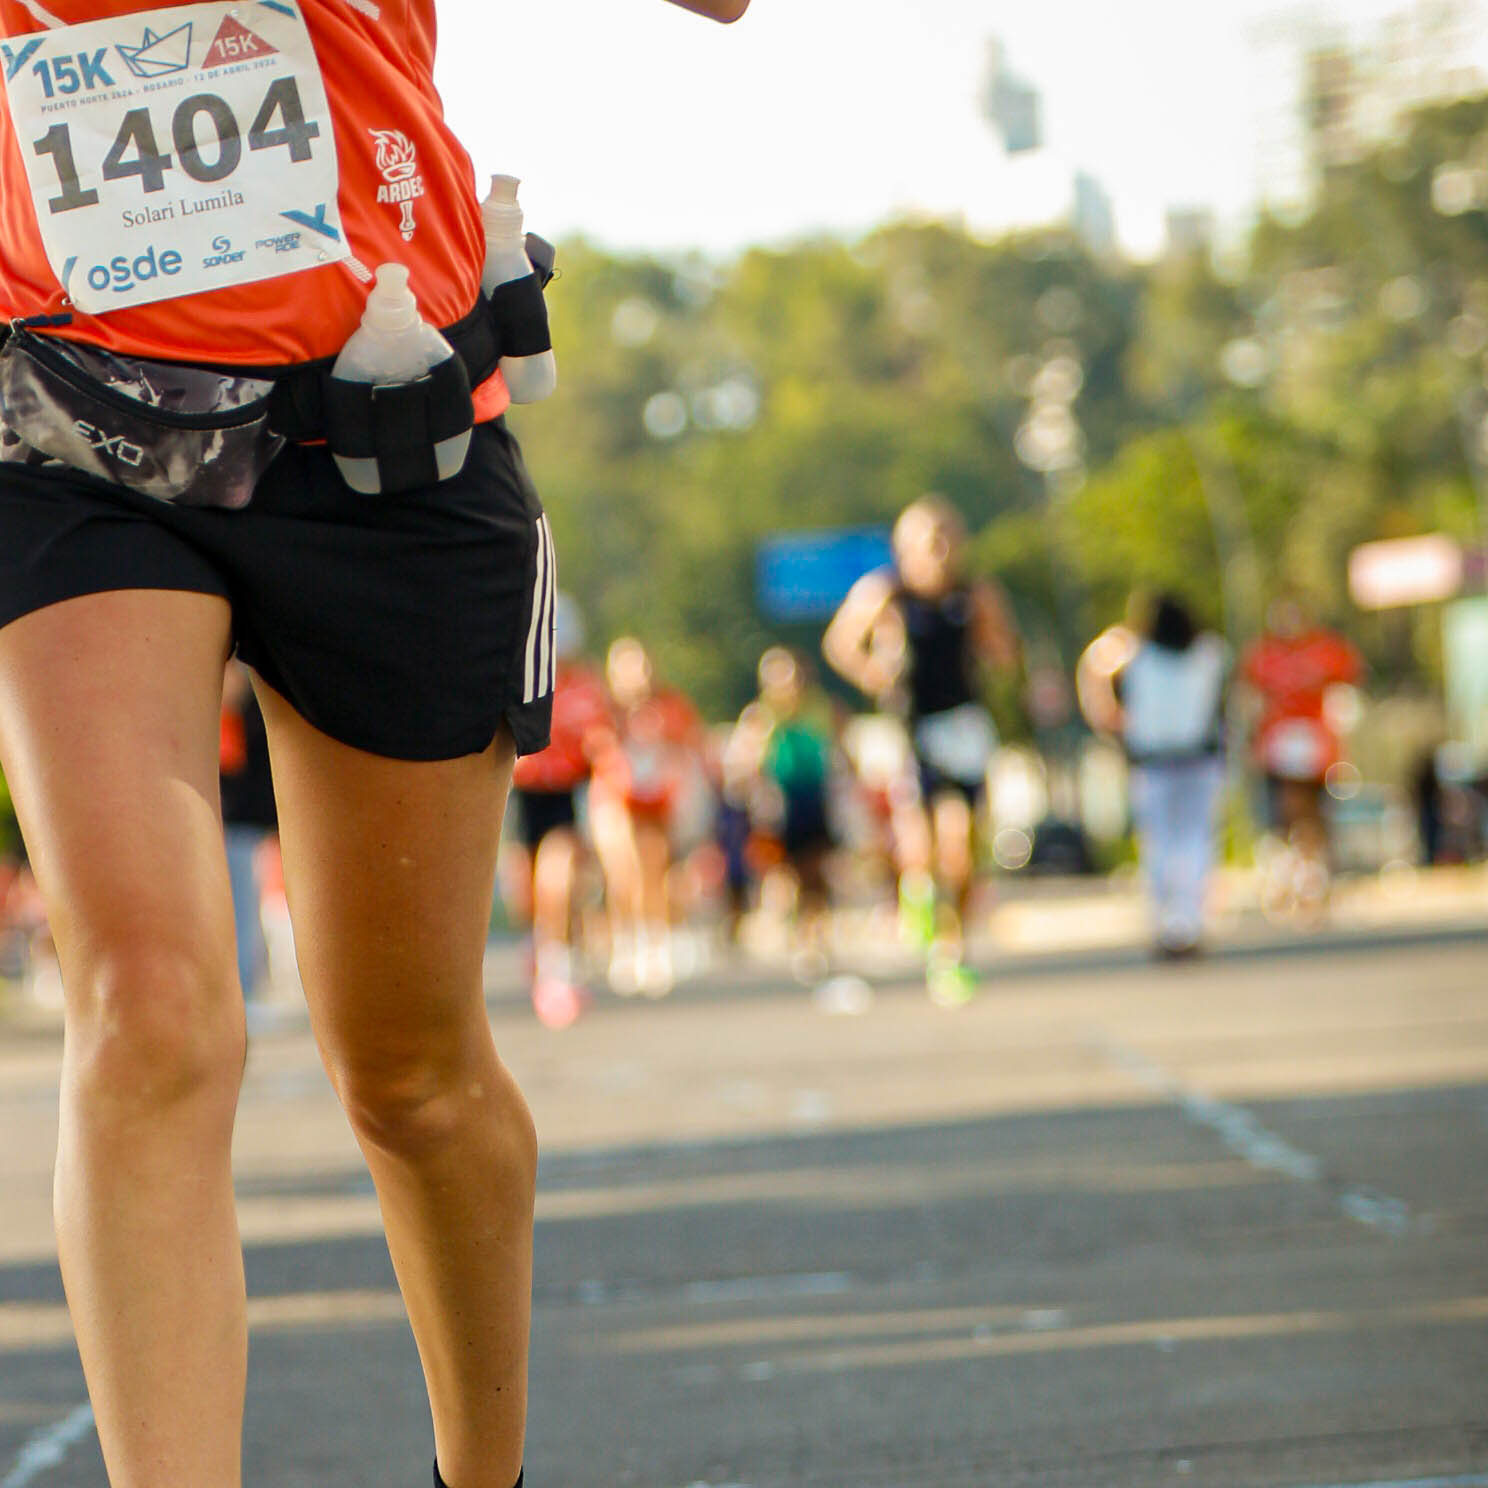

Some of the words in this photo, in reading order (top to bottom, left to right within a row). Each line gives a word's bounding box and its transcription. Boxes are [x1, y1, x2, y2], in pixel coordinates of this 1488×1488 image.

[214, 33, 259, 58] 15K
[33, 47, 117, 99] 15K
[40, 100, 77, 113] PUERTO
[33, 75, 320, 214] 1404
[122, 202, 175, 228] Solari
[179, 189, 245, 216] Lumila
[87, 245, 183, 291] osde
